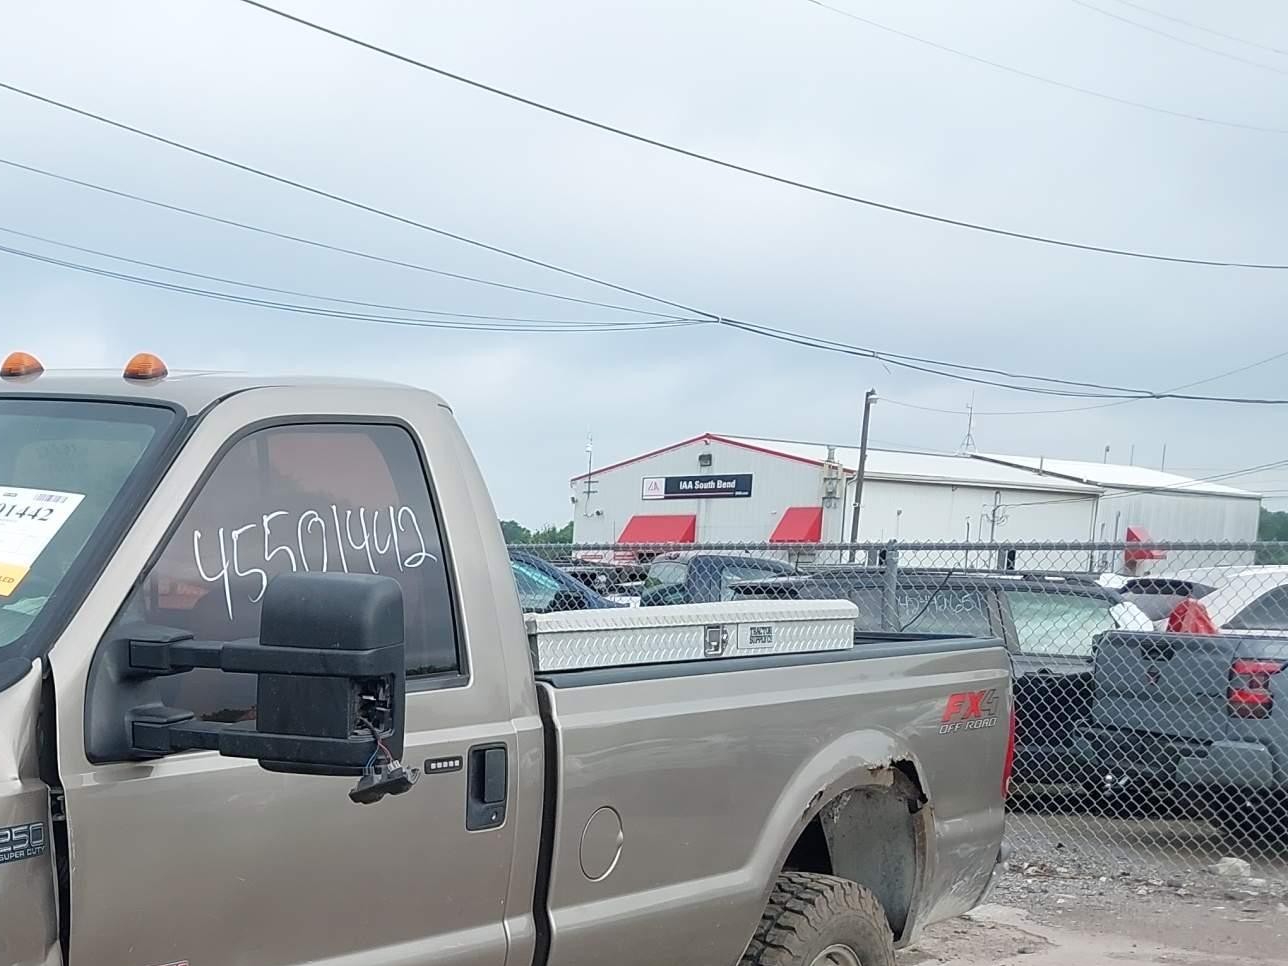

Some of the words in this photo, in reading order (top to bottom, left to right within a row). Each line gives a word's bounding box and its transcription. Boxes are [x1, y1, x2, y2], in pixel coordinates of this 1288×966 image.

[679, 480, 693, 490] IAA
[695, 480, 715, 490] South
[717, 480, 736, 489] Bend
[193, 504, 437, 620] 45501442
[941, 688, 999, 722] FX4
[939, 722, 963, 735] OFF
[965, 717, 997, 731] ROAD
[27, 846, 45, 857] DUTY
